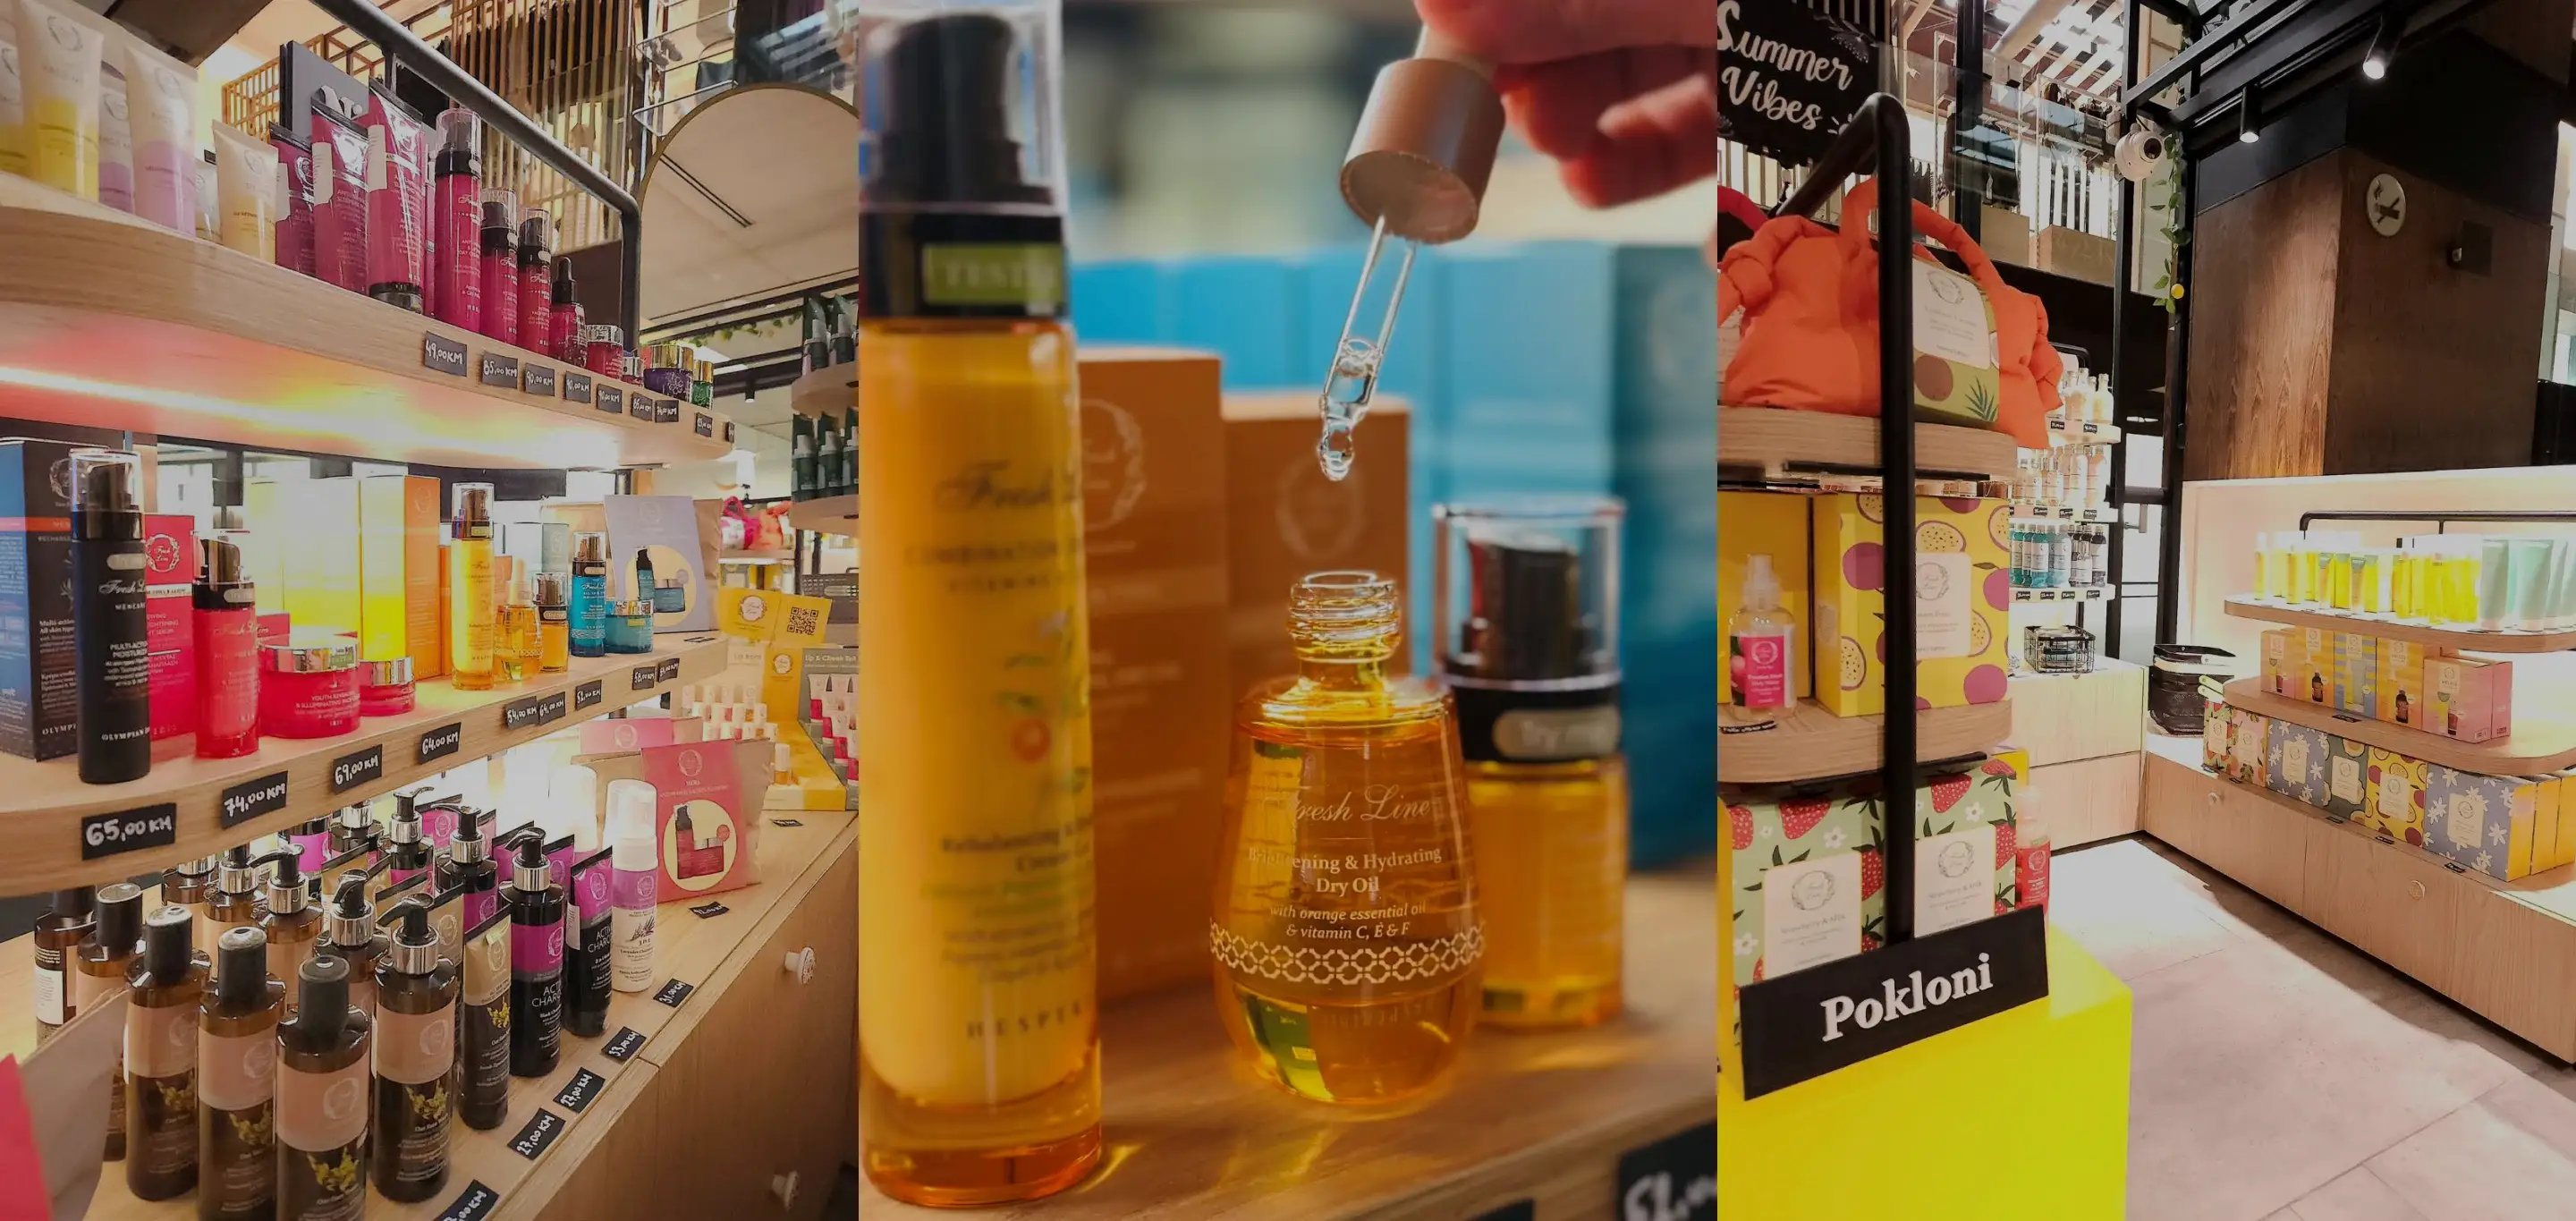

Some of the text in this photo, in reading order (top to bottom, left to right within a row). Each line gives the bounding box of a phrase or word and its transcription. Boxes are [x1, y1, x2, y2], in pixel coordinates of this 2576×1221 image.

[1717, 0, 1852, 90] Summer
[1721, 66, 1823, 130] Vibes
[1360, 784, 1431, 820] Line
[86, 815, 172, 846] 65,00 KM
[1345, 855, 1359, 869] &
[1363, 848, 1443, 872] Hydrating
[1316, 876, 1380, 897] Dry Oil
[1270, 900, 1428, 925] with orange essential oil
[1286, 925, 1298, 937] &
[1301, 926, 1352, 940] vitamin
[1386, 924, 1399, 937] &
[1401, 921, 1411, 936] F
[1819, 952, 1994, 1042] Pokloni
